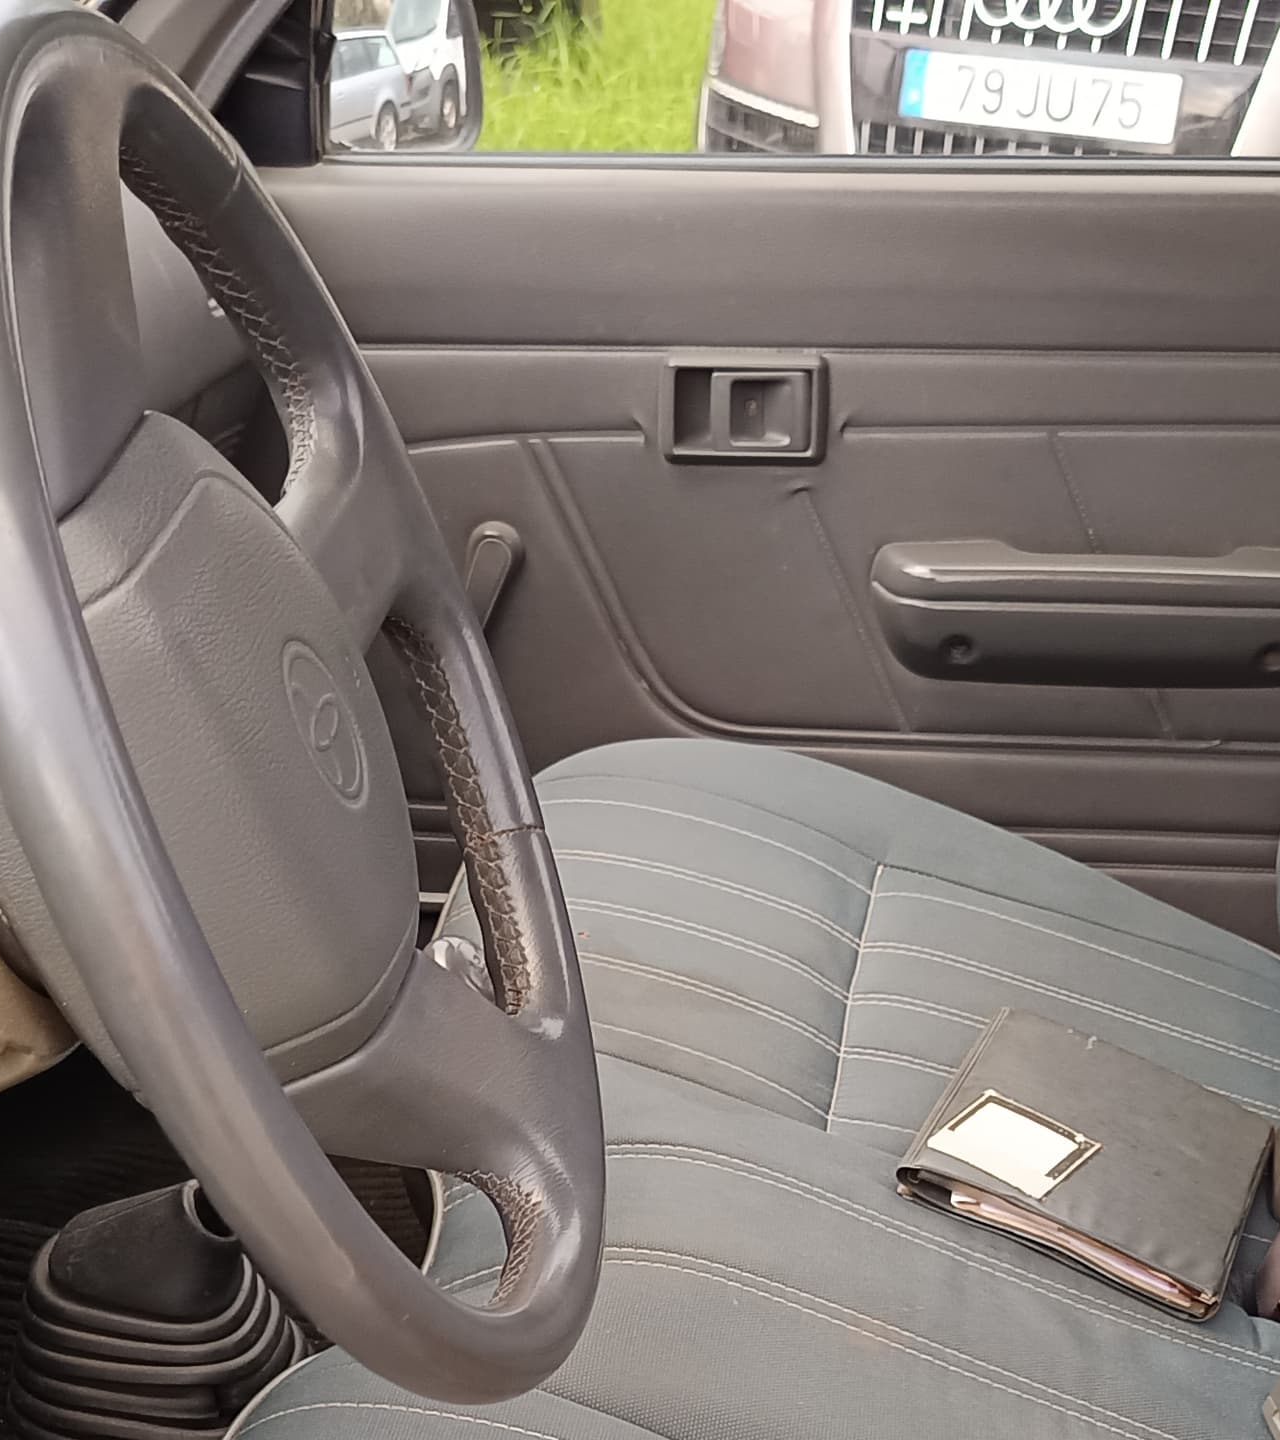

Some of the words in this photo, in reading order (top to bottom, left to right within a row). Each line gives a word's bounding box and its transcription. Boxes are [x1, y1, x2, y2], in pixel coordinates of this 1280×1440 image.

[955, 64, 1005, 115] 79
[1015, 73, 1079, 124] JU
[1089, 76, 1144, 130] 75
